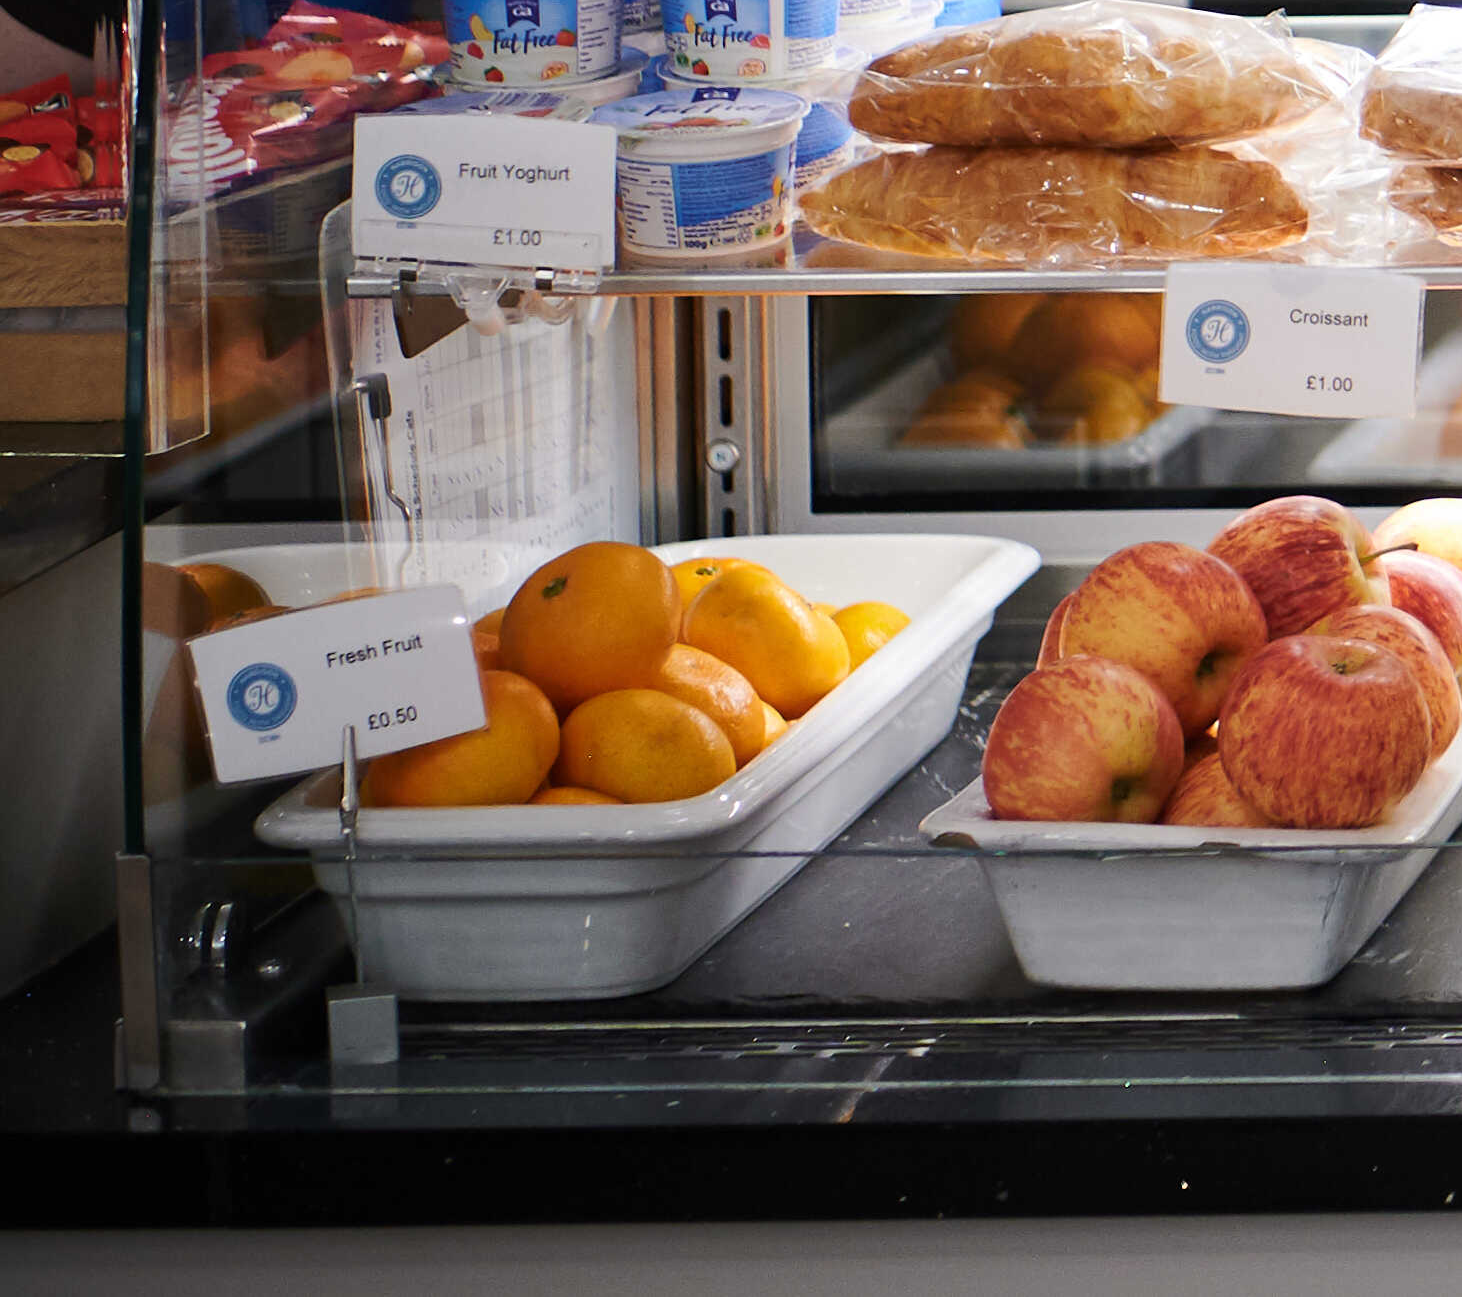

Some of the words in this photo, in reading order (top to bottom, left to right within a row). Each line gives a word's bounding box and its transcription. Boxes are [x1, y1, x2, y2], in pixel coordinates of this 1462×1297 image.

[493, 28, 521, 54] Fat
[524, 26, 557, 50] Free
[694, 23, 721, 48] Fat
[722, 23, 754, 44] Free
[459, 163, 497, 179] Fruit
[503, 165, 569, 183] Yoghurt
[493, 229, 543, 246] £1.00
[1290, 309, 1368, 327] Croissant
[1306, 375, 1352, 392] £1.00
[326, 645, 377, 668] Fresh
[382, 635, 423, 655] Fruit
[368, 706, 417, 730] £0.50
